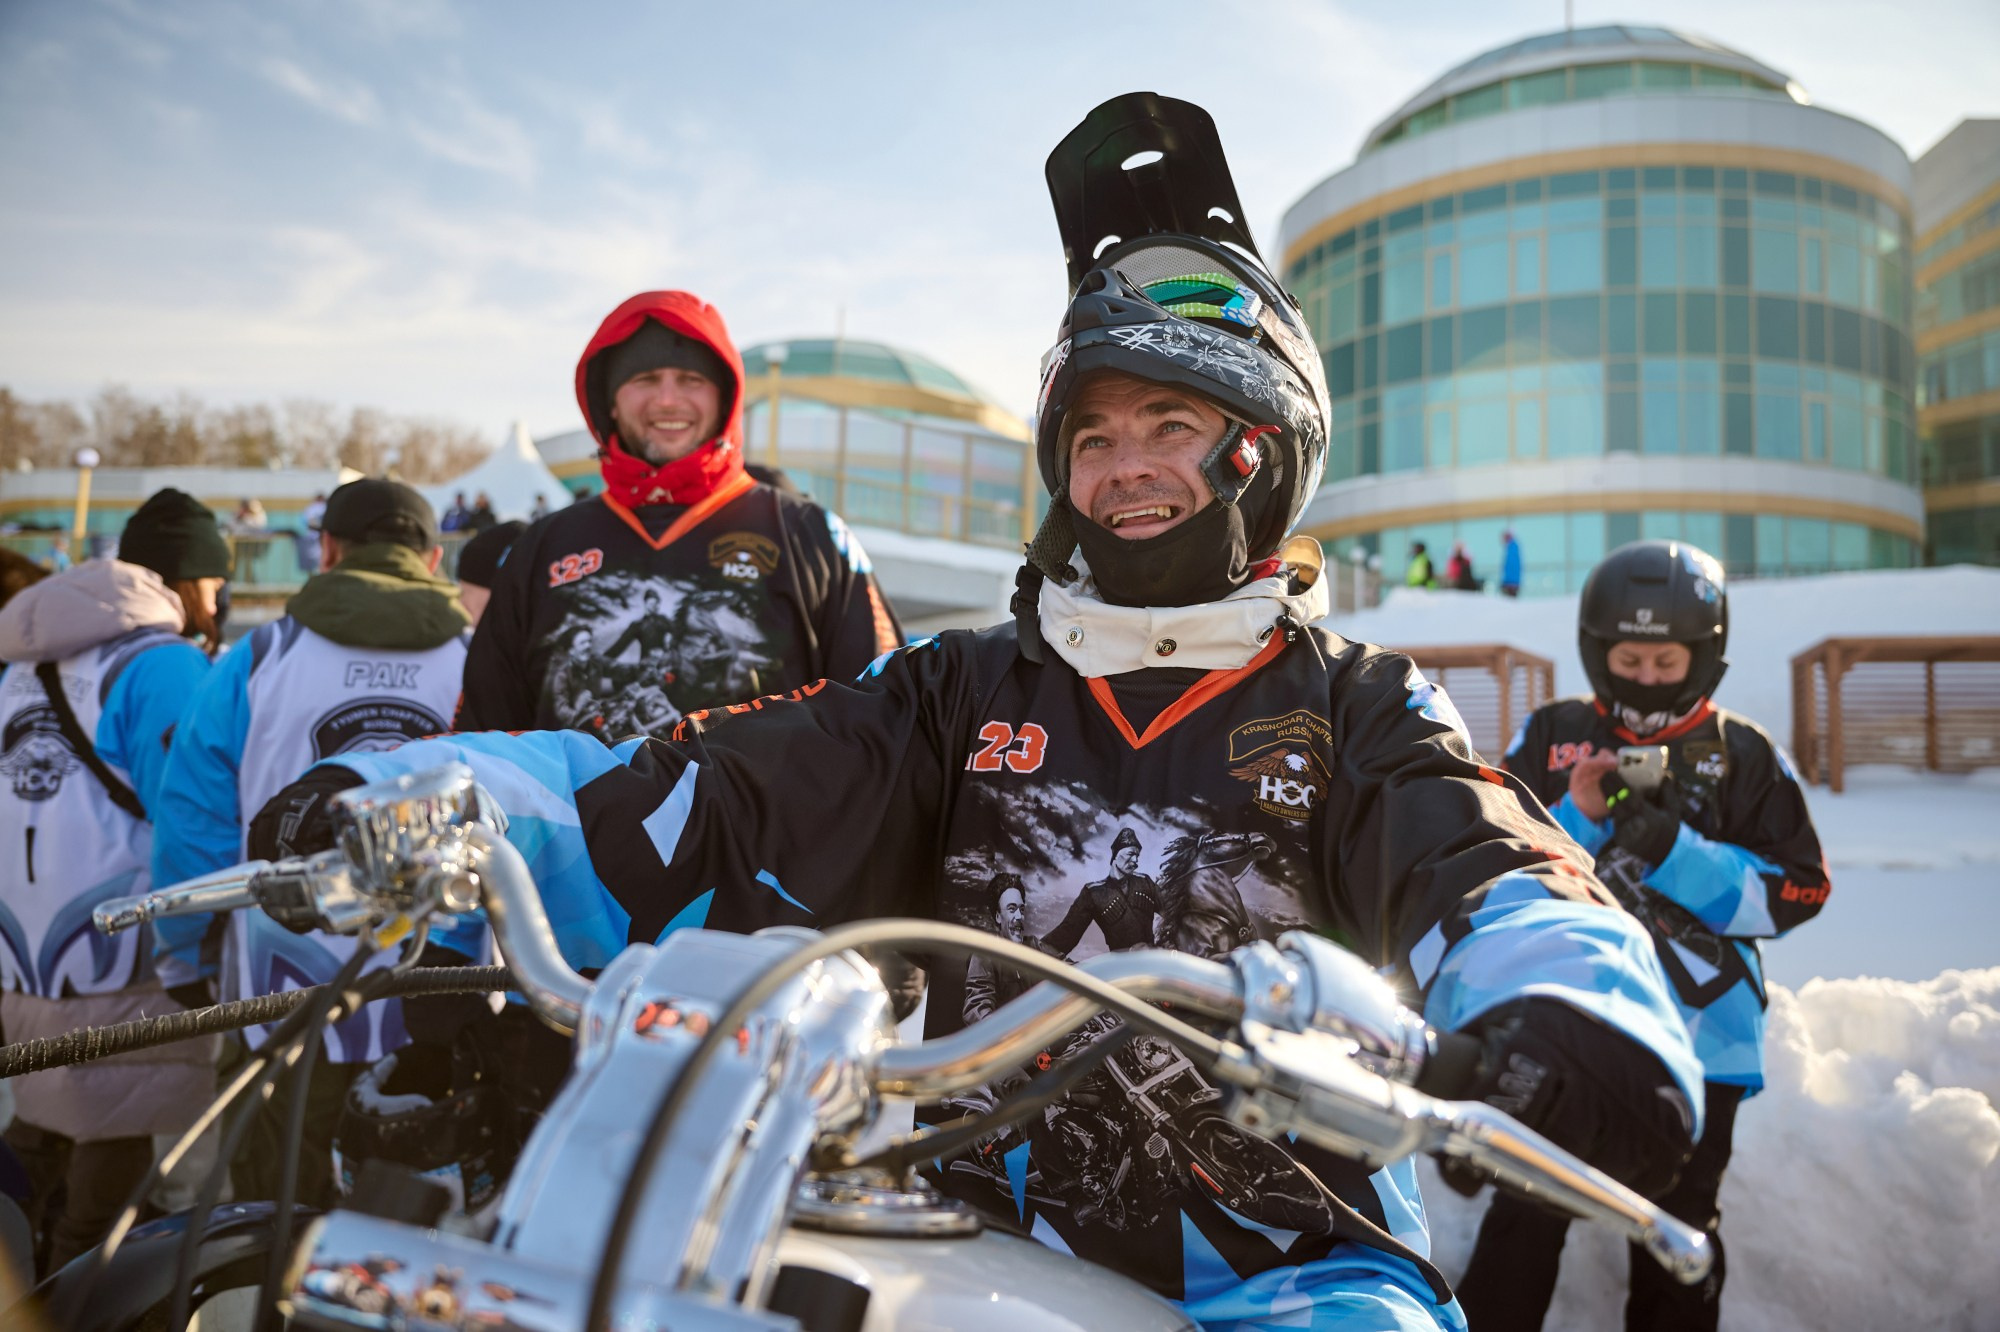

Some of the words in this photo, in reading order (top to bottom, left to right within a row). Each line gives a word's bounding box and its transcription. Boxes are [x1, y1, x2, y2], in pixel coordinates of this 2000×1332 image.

[344, 660, 422, 689] PAK
[362, 719, 403, 731] RUSSIA
[381, 706, 435, 731] CHAPTER
[1241, 715, 1303, 736] KRASNODAR
[1305, 717, 1334, 746] CHAPTE
[1277, 725, 1313, 741] RUSSIA
[965, 720, 1049, 774] 23
[1280, 807, 1299, 817] OWNERS
